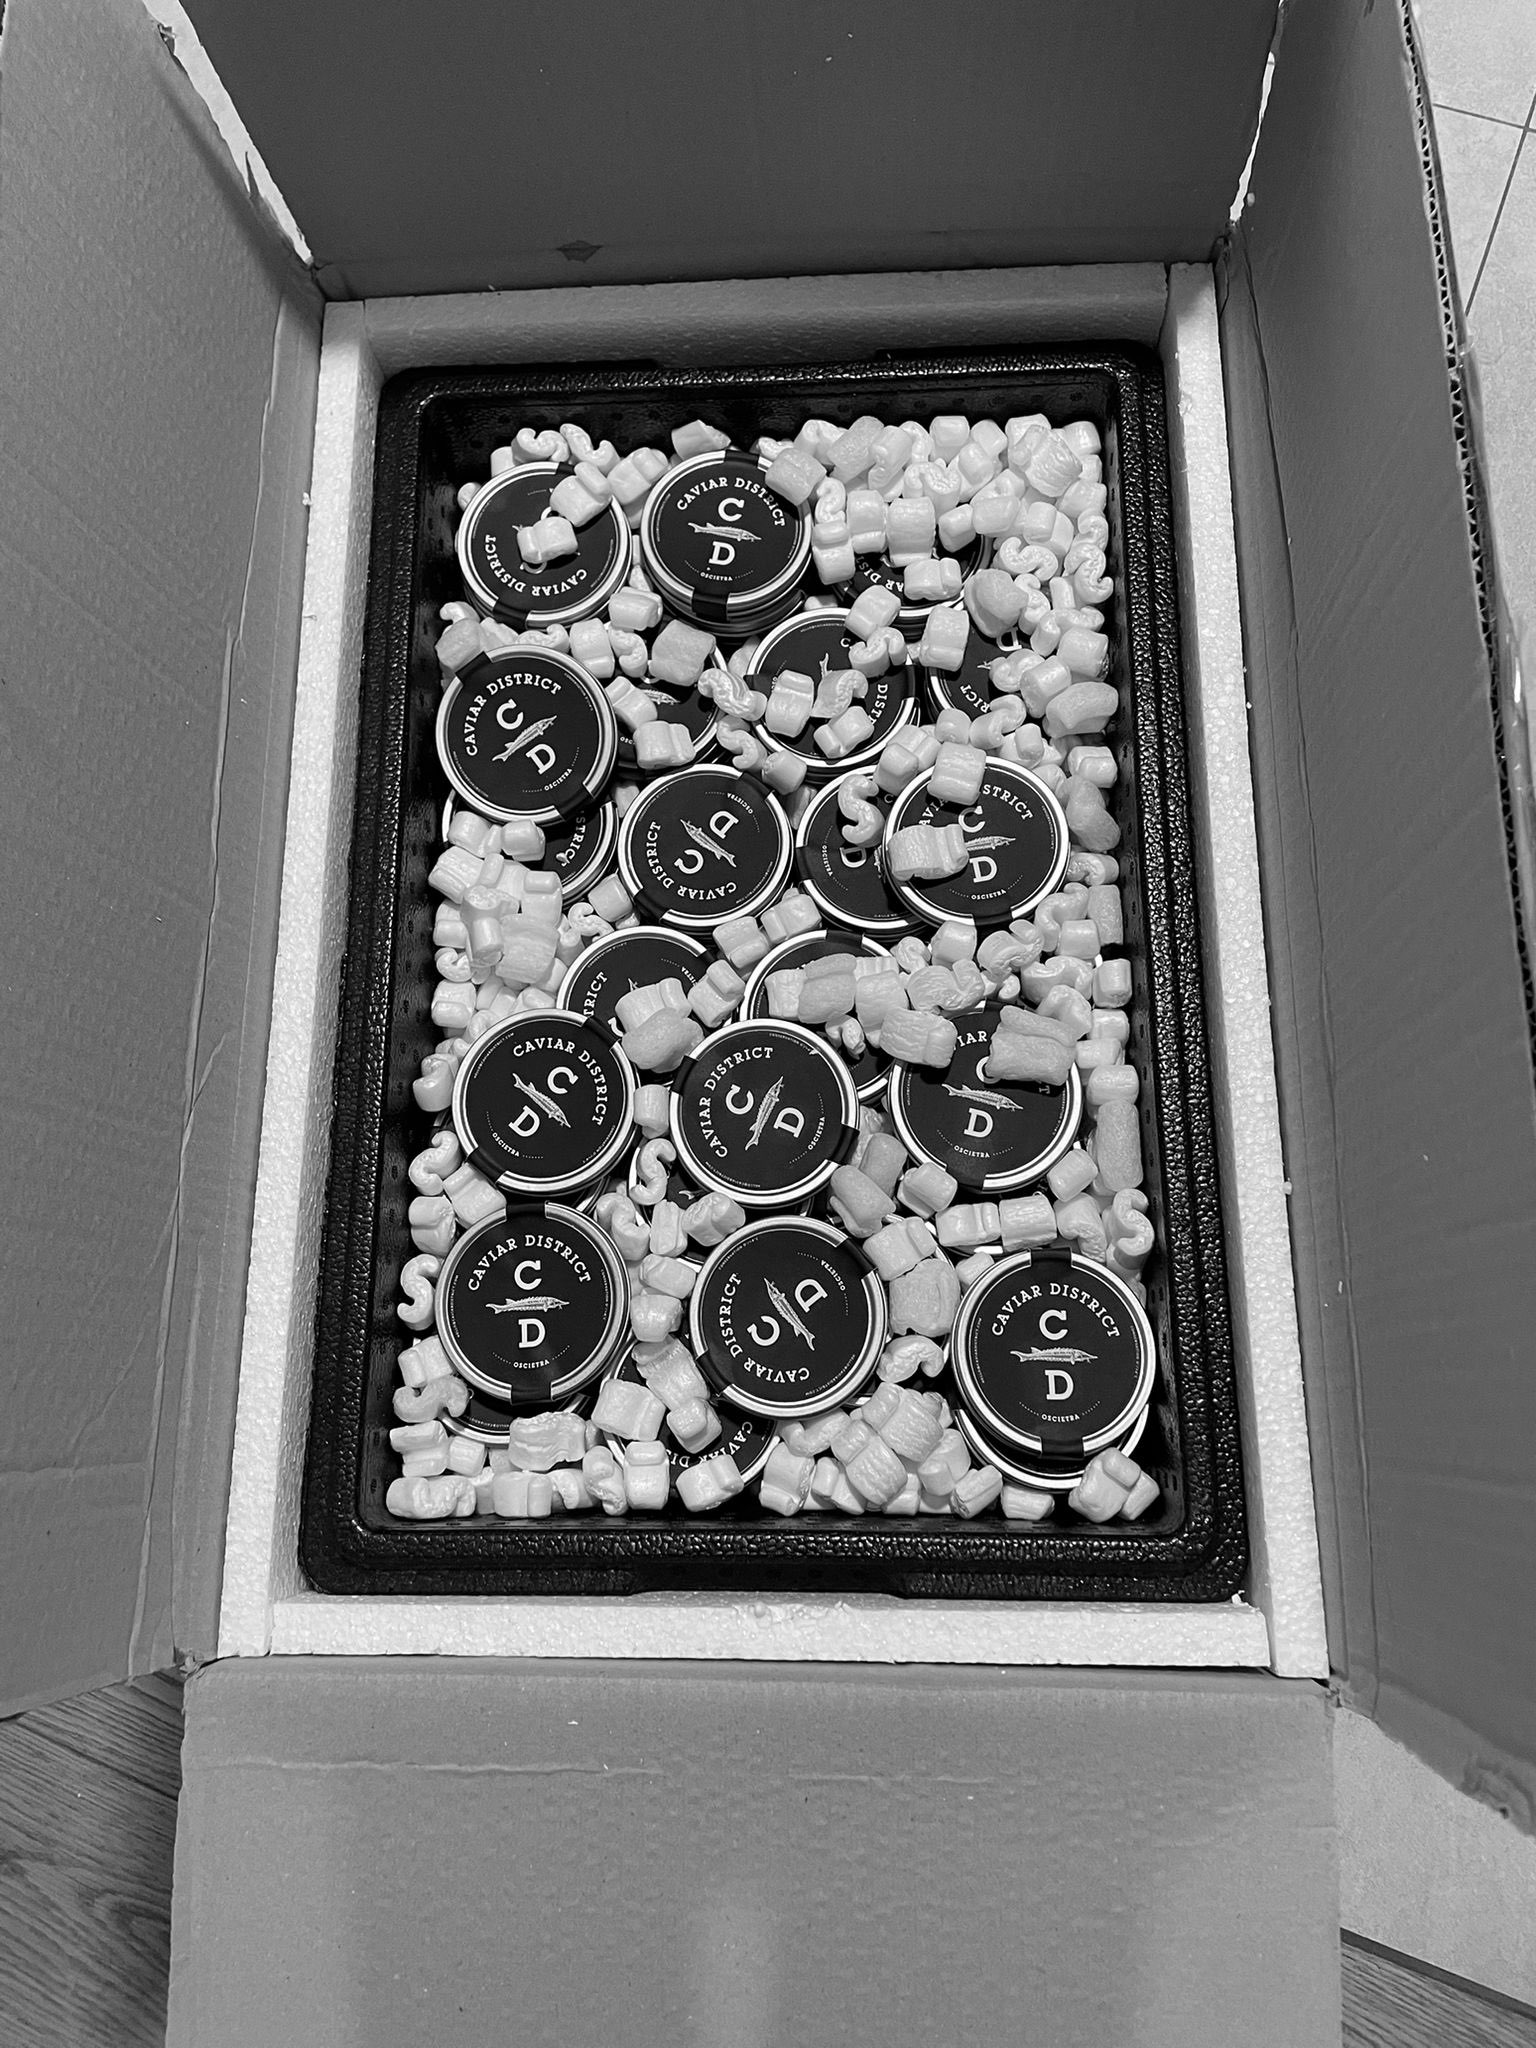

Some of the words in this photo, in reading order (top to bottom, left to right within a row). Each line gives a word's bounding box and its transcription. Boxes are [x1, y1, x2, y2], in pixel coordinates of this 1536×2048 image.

[676, 476, 729, 511] CAVIAR
[734, 477, 786, 527] DISTRICT
[717, 497, 745, 522] C
[484, 534, 527, 593] DISTRICT
[708, 541, 736, 566] D
[531, 569, 588, 597] CAVIAR
[464, 695, 487, 756] CAVIAR
[486, 673, 562, 695] DISTRICT
[496, 698, 524, 730] C
[525, 743, 556, 775] D
[982, 784, 1034, 820] STRICT
[709, 810, 739, 839] D
[958, 805, 986, 833] C
[646, 821, 675, 889] DISTRICT
[673, 849, 704, 874] C
[969, 856, 998, 883] D
[677, 881, 737, 900] CAVIAR
[513, 1037, 576, 1057] CAVIAR
[578, 1050, 608, 1126] DISTRICT
[547, 1066, 579, 1094] C
[704, 1047, 774, 1091] DISTRICT
[725, 1084, 754, 1115] C
[508, 1105, 540, 1137] D
[699, 1096, 729, 1157] CAVIAR
[773, 1107, 805, 1138] D
[963, 1107, 994, 1138] D
[468, 1238, 518, 1291] CAVIAR
[525, 1234, 591, 1283] DISTRICT
[514, 1260, 542, 1290] C
[794, 1278, 828, 1313] D
[991, 1284, 1043, 1336] CAVIAR
[1050, 1282, 1121, 1338] DISTRICT
[719, 1273, 743, 1358] DISTRICT
[746, 1315, 780, 1346] C
[1039, 1309, 1068, 1341] C
[518, 1318, 546, 1349] D
[513, 1359, 550, 1369] OSCIETRA
[743, 1357, 810, 1384] CAVIAR
[1044, 1369, 1074, 1400] D
